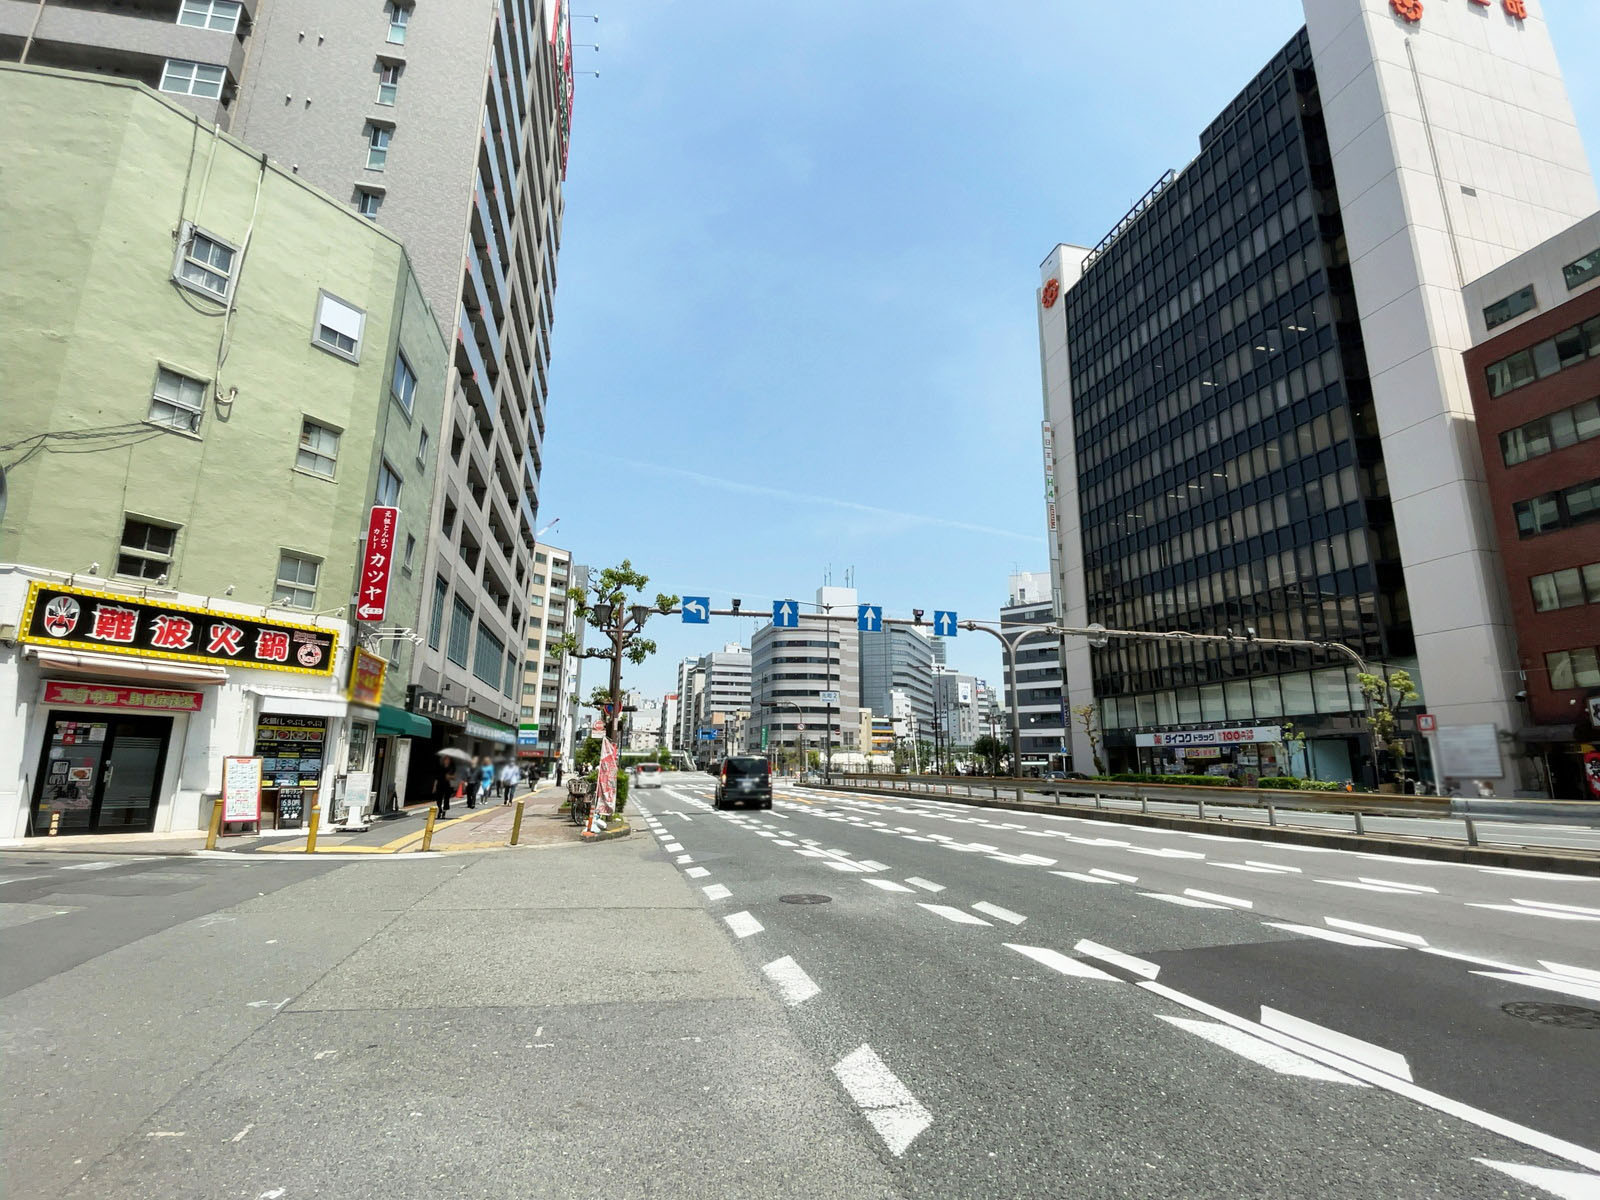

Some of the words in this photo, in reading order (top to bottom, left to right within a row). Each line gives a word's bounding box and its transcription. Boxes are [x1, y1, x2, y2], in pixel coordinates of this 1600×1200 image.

[365, 552, 386, 601] カツヤ
[90, 604, 289, 661] 難波火鍋
